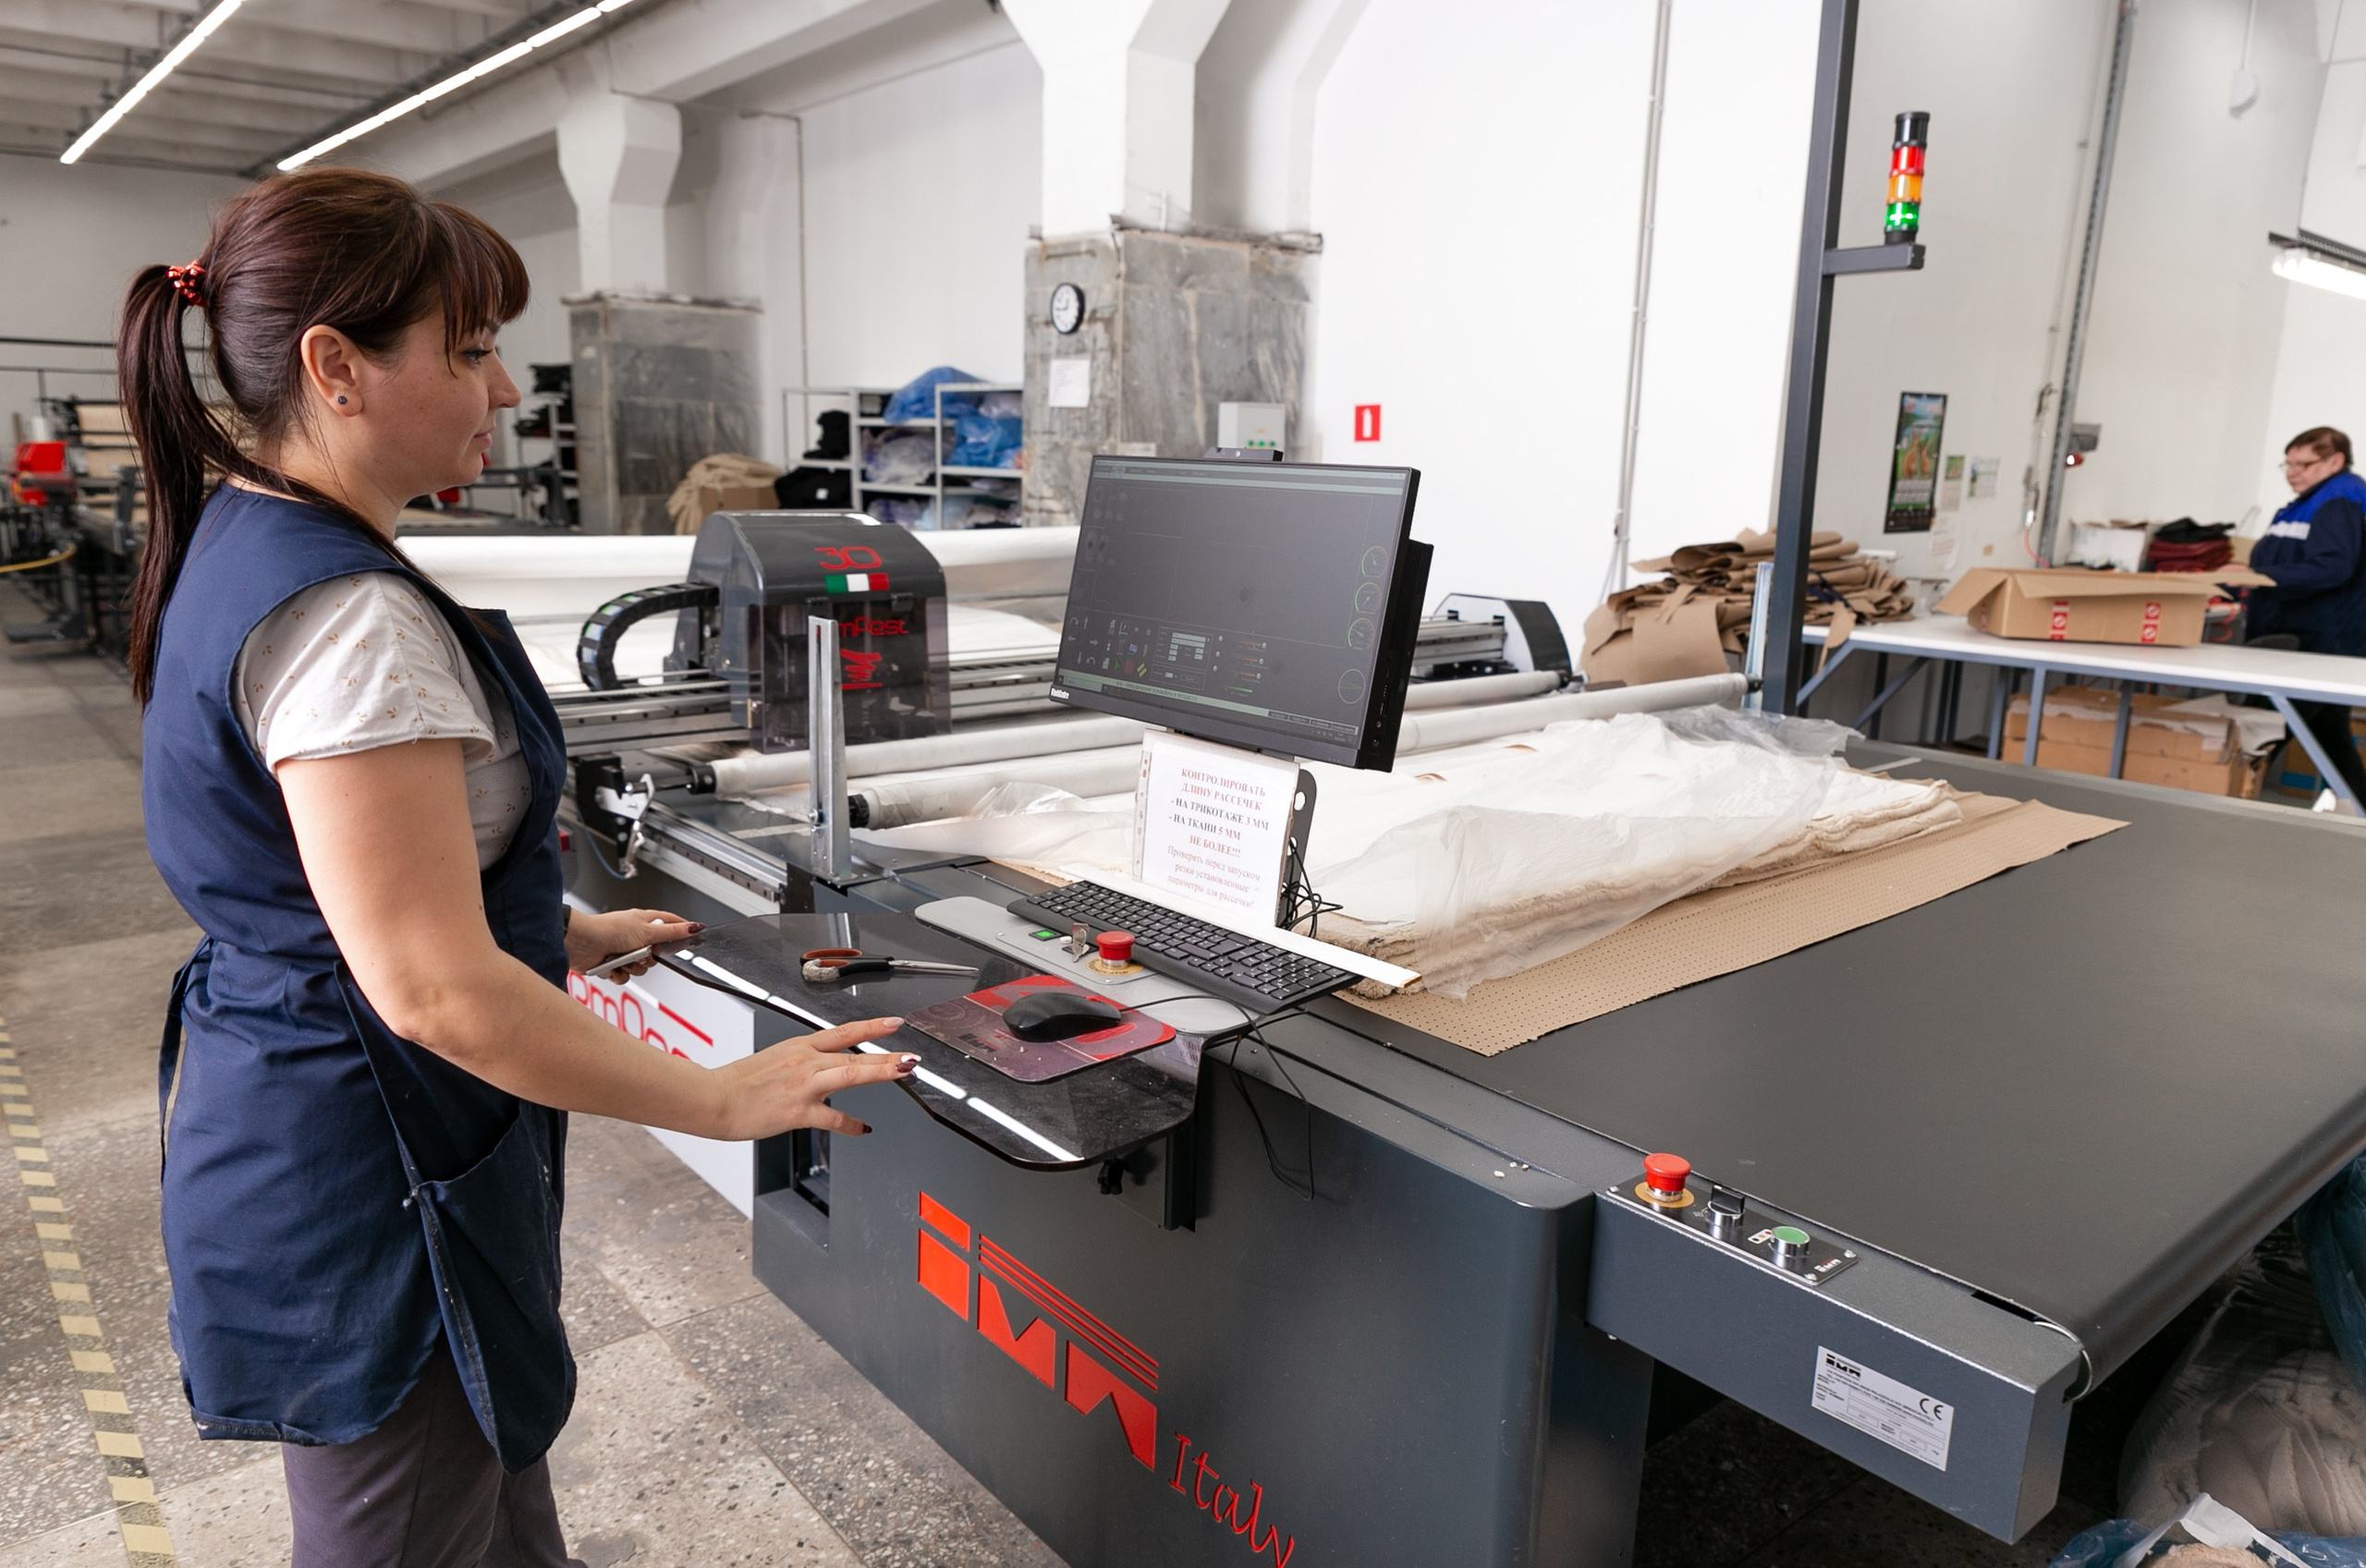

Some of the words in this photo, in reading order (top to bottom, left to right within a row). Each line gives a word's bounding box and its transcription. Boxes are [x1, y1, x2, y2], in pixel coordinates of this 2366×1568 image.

[1181, 768, 1266, 796] КОНТРОЛИРОВАТЬ
[1181, 783, 1213, 797] ДЛИНУ
[1213, 790, 1262, 811] РАССЕЧЕК
[1173, 813, 1186, 825] НА
[1188, 818, 1217, 833] ТКАНИ
[1218, 826, 1224, 835] 5
[1225, 829, 1240, 841] ММ
[1176, 797, 1189, 809] НА
[1190, 801, 1244, 824] ТРИКОТАЖЕ
[1245, 817, 1251, 826] 3
[1252, 819, 1269, 831] ММ
[1189, 835, 1201, 847] НЕ
[1202, 838, 1241, 858] БОЛЕЕ!!!
[1167, 845, 1203, 864] Проверять
[1205, 858, 1226, 871] перед
[1227, 865, 1261, 881] запуском
[1167, 875, 1204, 893] параметры
[1205, 888, 1218, 898] для
[1219, 893, 1254, 908] рассечки!
[1175, 864, 1194, 876] резки
[1196, 869, 1250, 893] установленные
